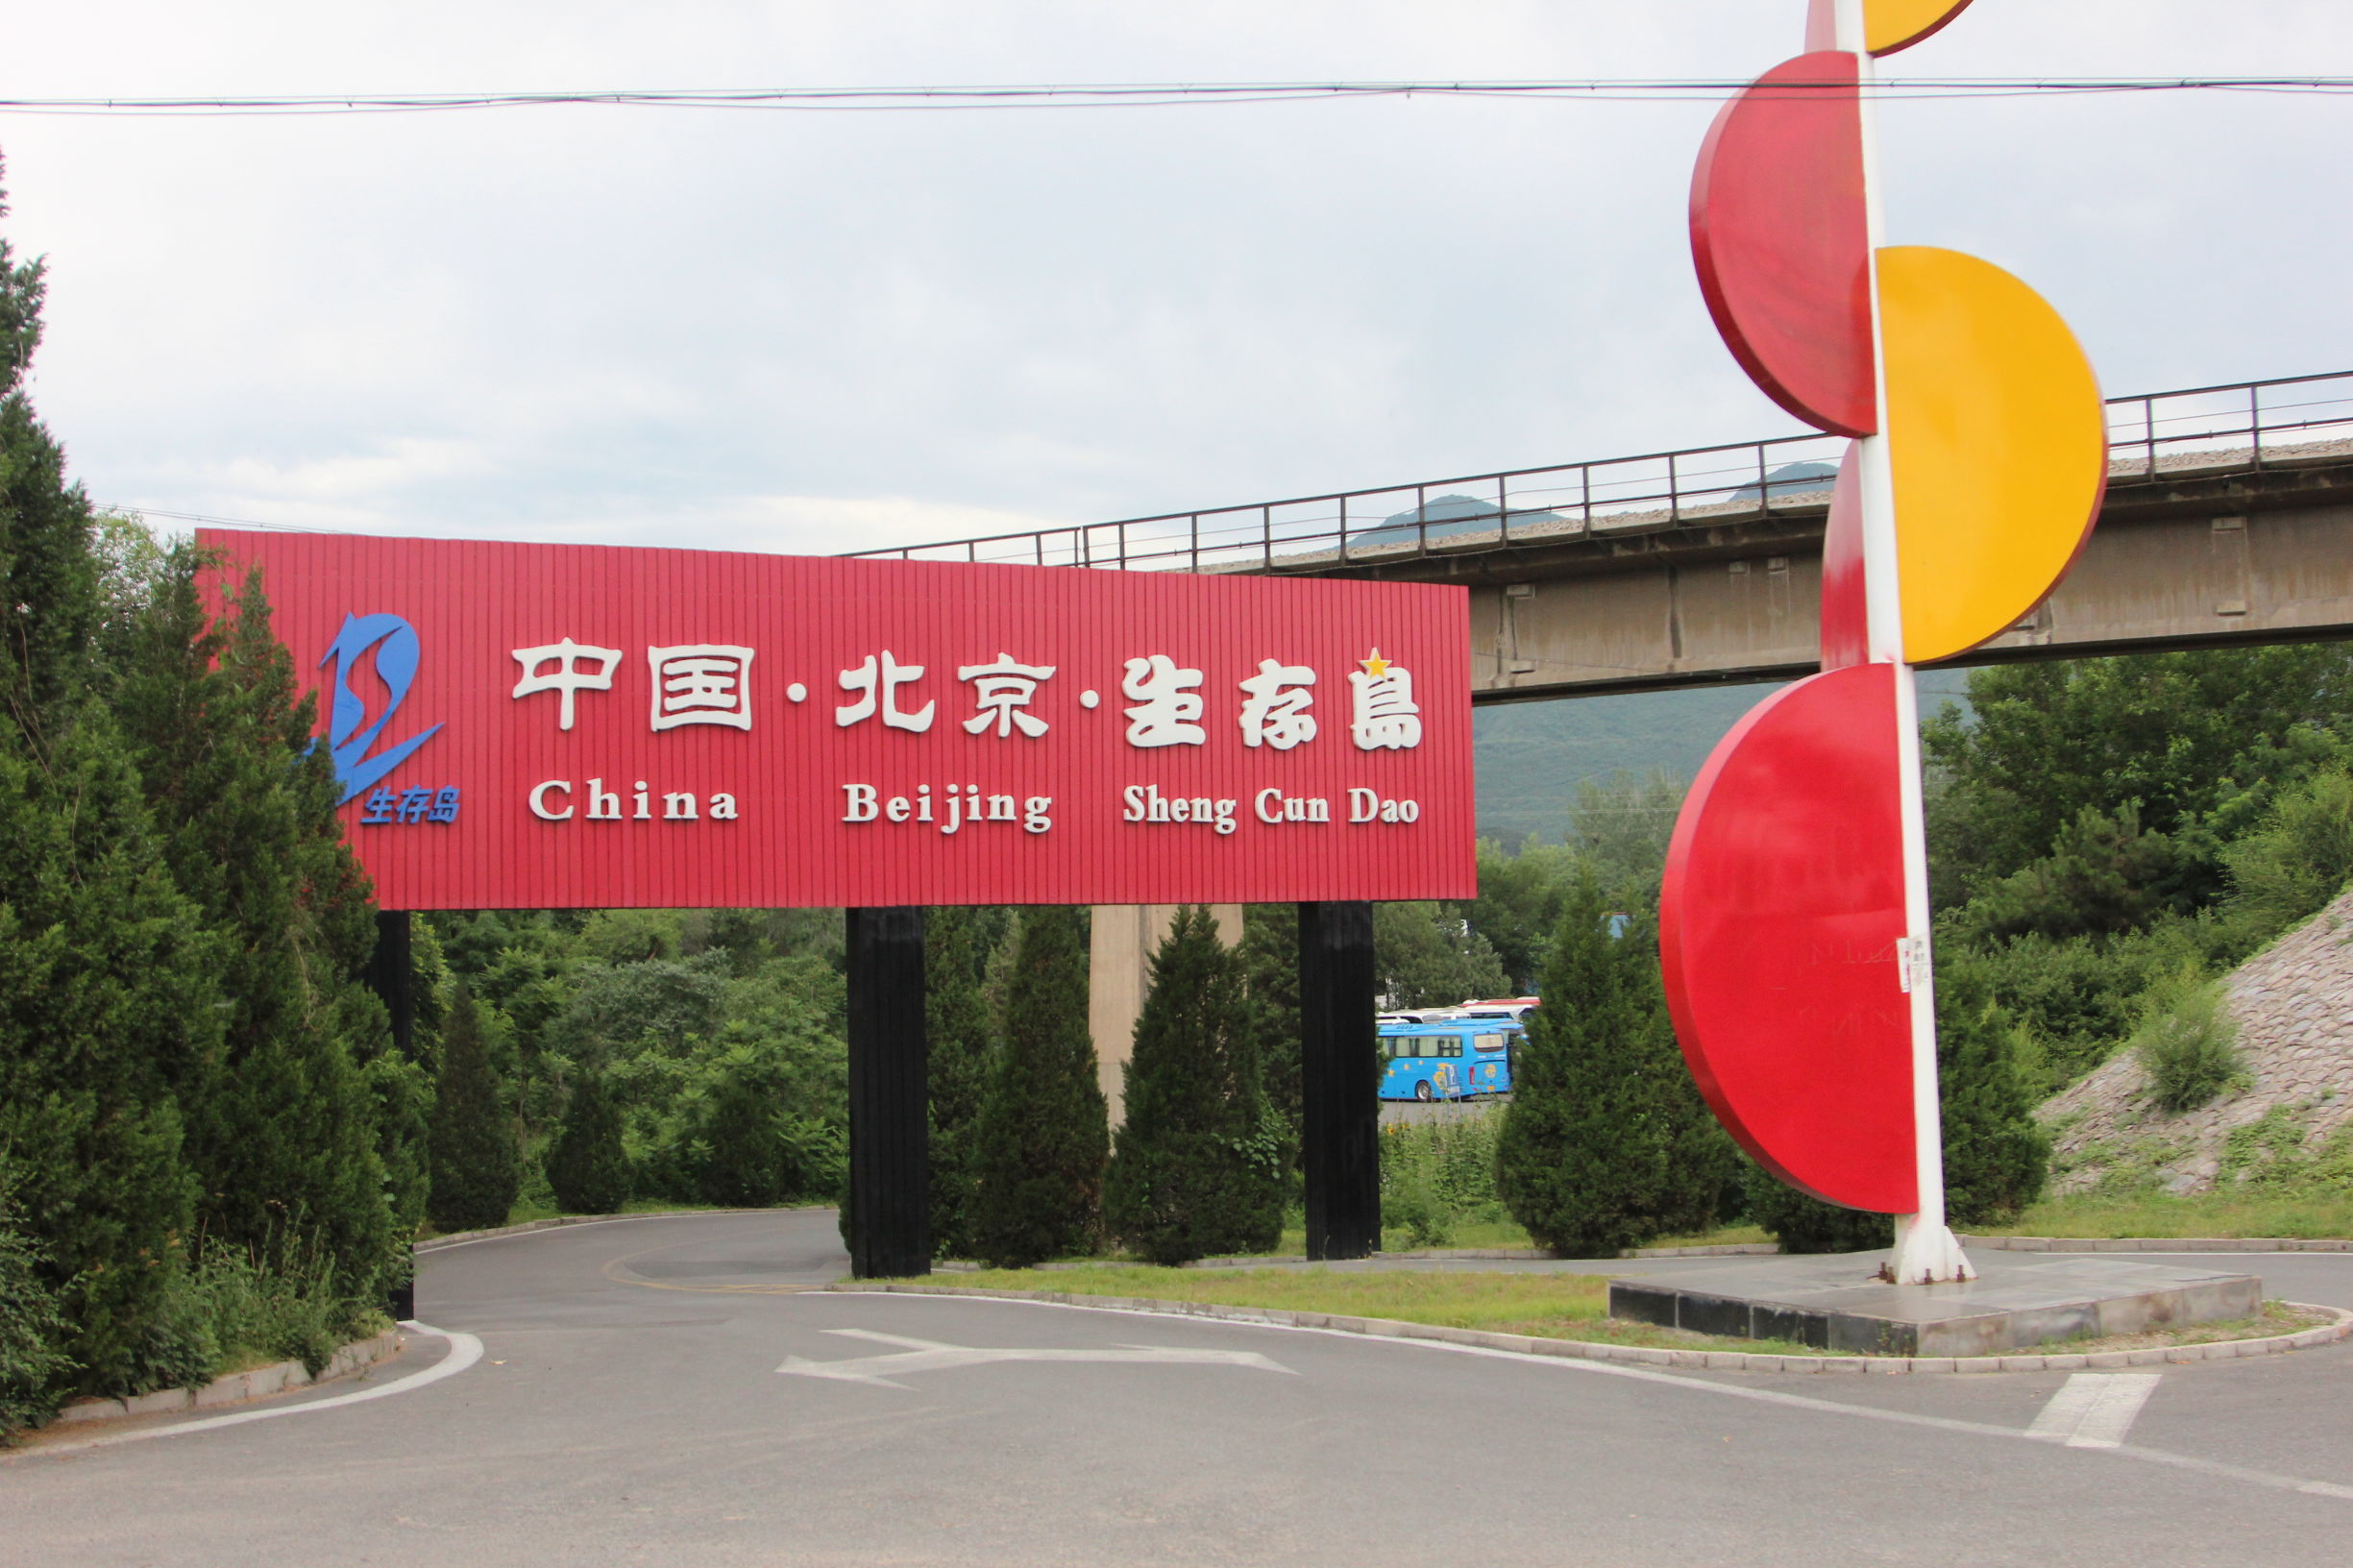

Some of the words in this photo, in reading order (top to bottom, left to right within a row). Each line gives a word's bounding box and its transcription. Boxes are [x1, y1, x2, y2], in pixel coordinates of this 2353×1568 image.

[360, 784, 460, 824] 生存岛
[528, 778, 739, 821] China
[843, 784, 1052, 834] Beijing
[1123, 785, 1237, 835] Sheng
[1255, 788, 1331, 823] Cun
[1348, 788, 1419, 823] Dao
